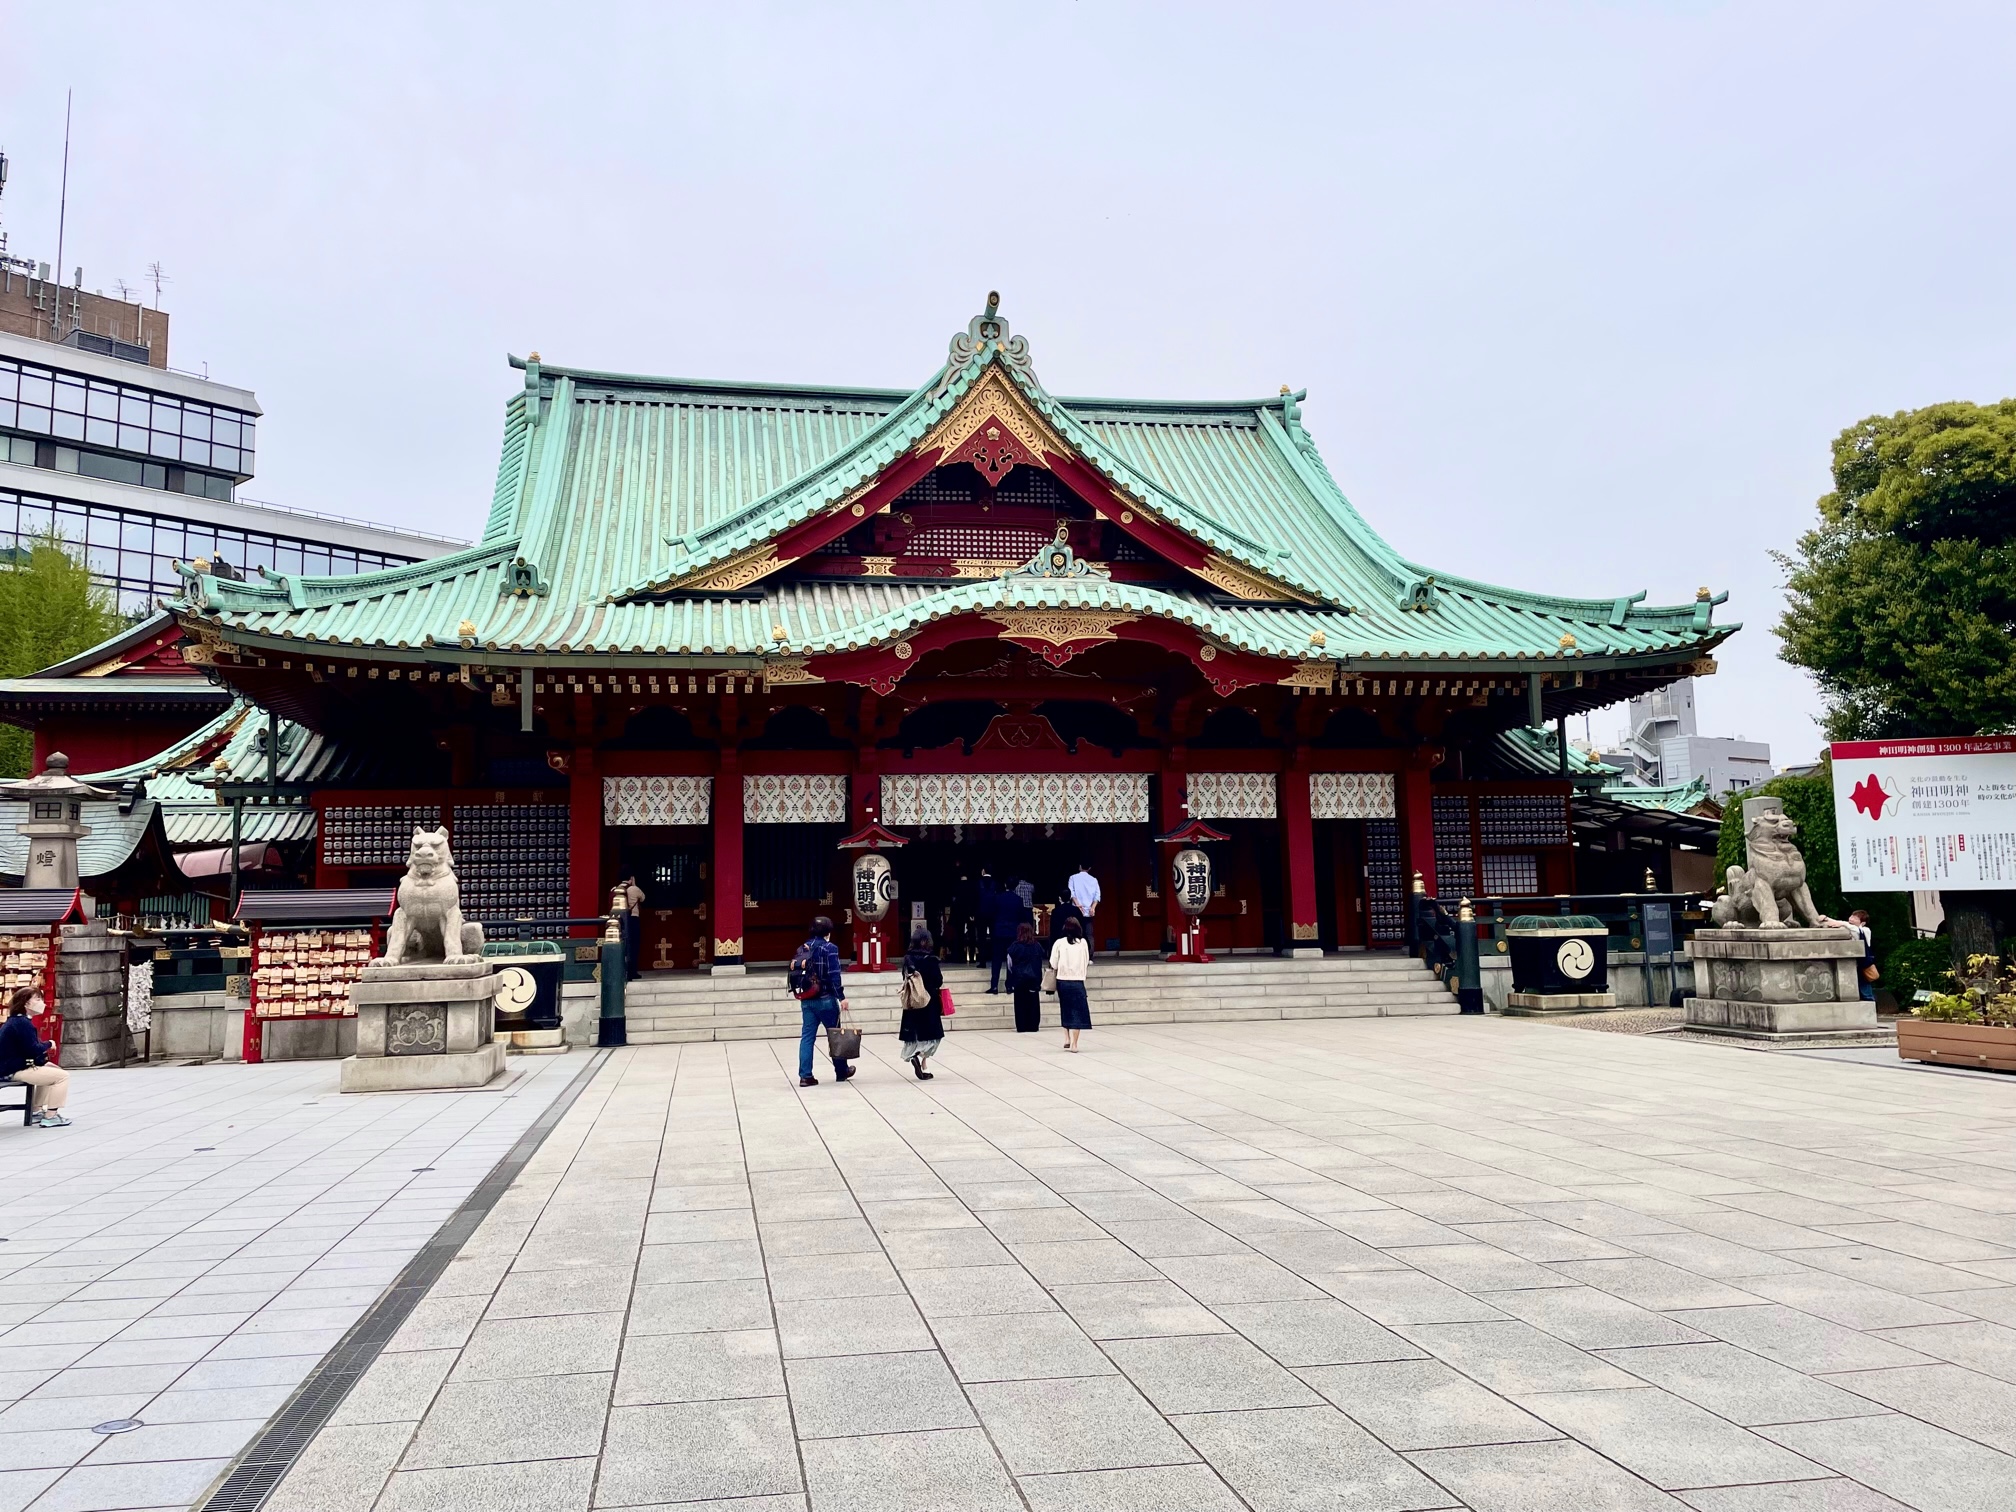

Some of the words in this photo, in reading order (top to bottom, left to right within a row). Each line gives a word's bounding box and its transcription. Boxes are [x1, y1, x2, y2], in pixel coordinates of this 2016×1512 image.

[1911, 784, 1969, 798] 神田明神
[1912, 799, 1970, 809] 創建1300年
[856, 868, 878, 913] 神田明神
[1186, 862, 1207, 905] 神田明神
